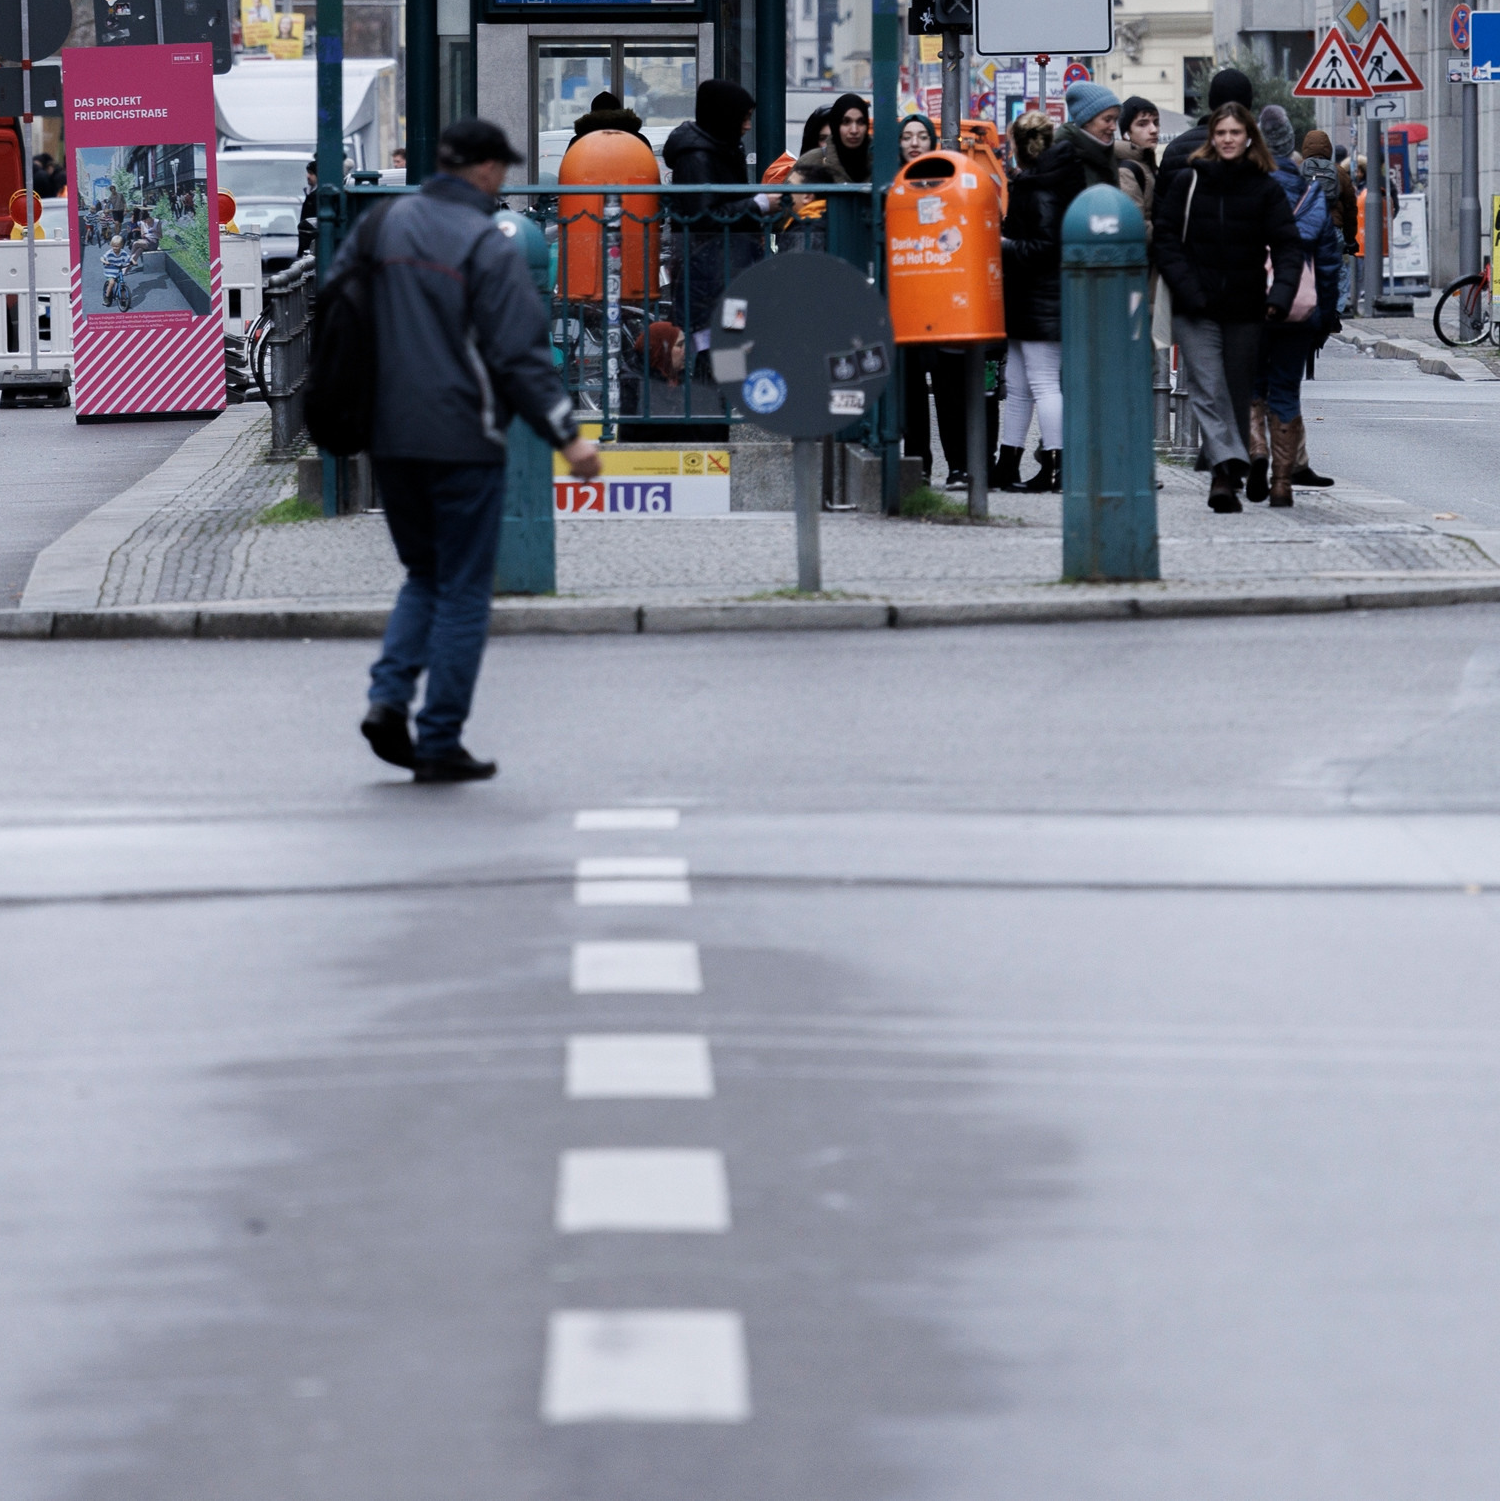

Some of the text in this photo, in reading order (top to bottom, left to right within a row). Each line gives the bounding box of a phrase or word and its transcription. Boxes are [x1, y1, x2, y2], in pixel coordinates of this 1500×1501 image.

[74, 96, 142, 108] DAS PROJEKT
[74, 108, 168, 121] FRIEDRICHSTRAßE
[921, 236, 936, 248] für
[892, 250, 952, 266] die Hot Dogs
[555, 485, 598, 514] U2
[617, 485, 666, 514] U6
